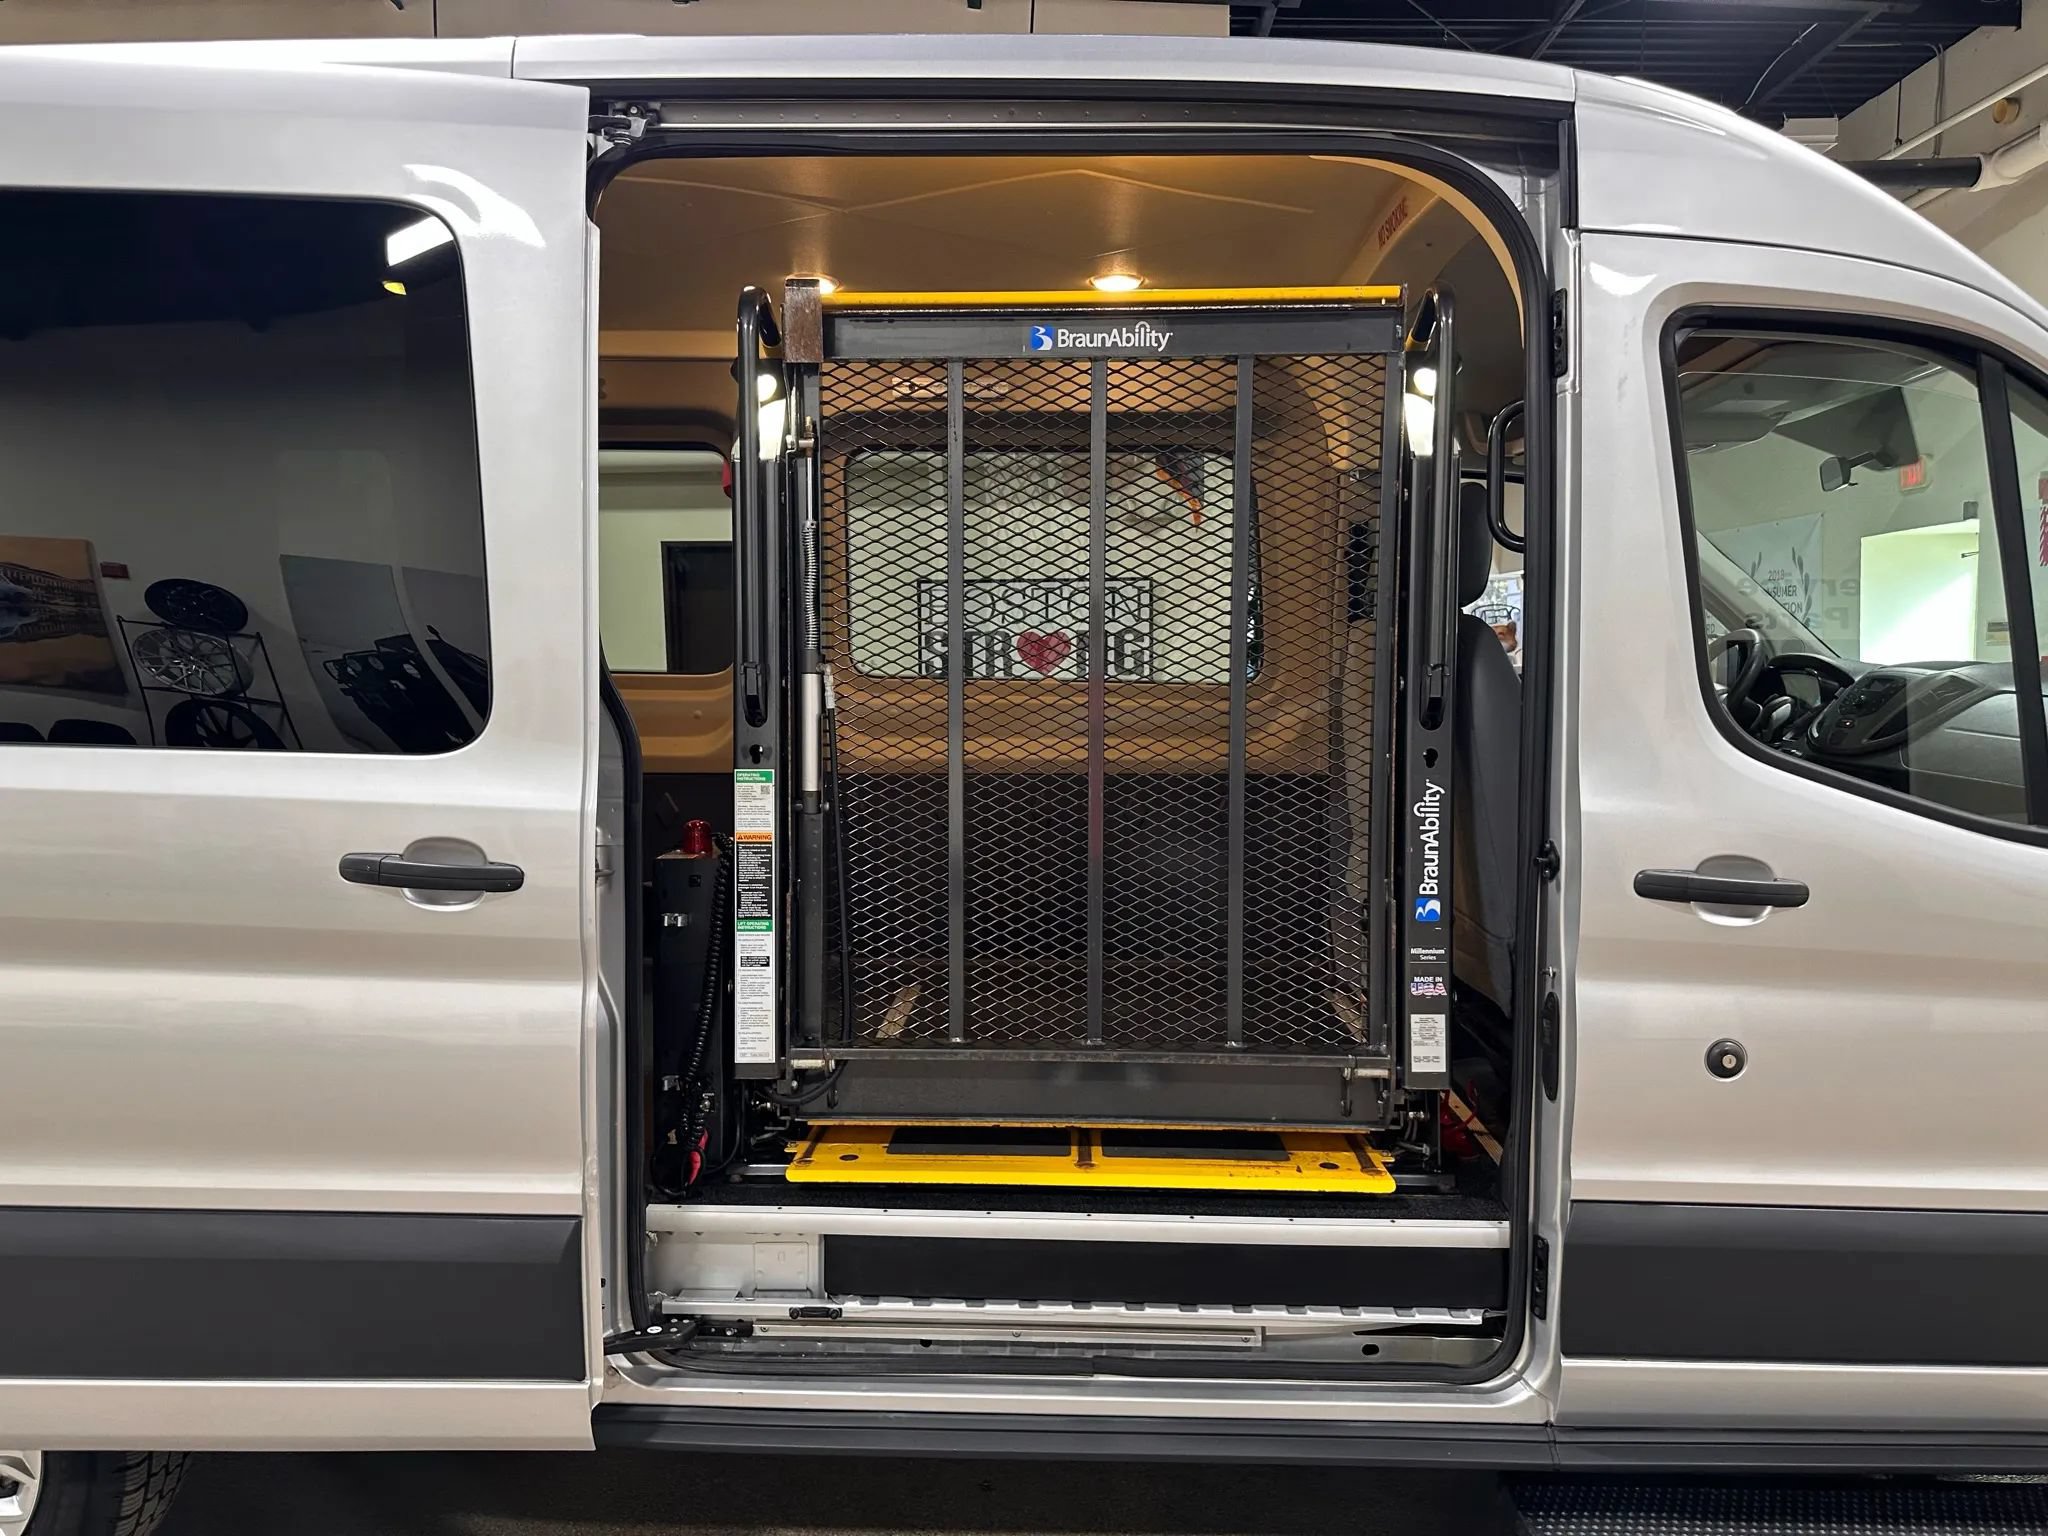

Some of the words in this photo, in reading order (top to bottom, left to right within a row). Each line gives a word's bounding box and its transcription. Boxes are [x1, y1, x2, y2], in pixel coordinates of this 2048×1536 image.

[1057, 320, 1173, 352] BraunAbility
[1413, 779, 1445, 895] BraunAbility
[1411, 982, 1448, 996] USA
